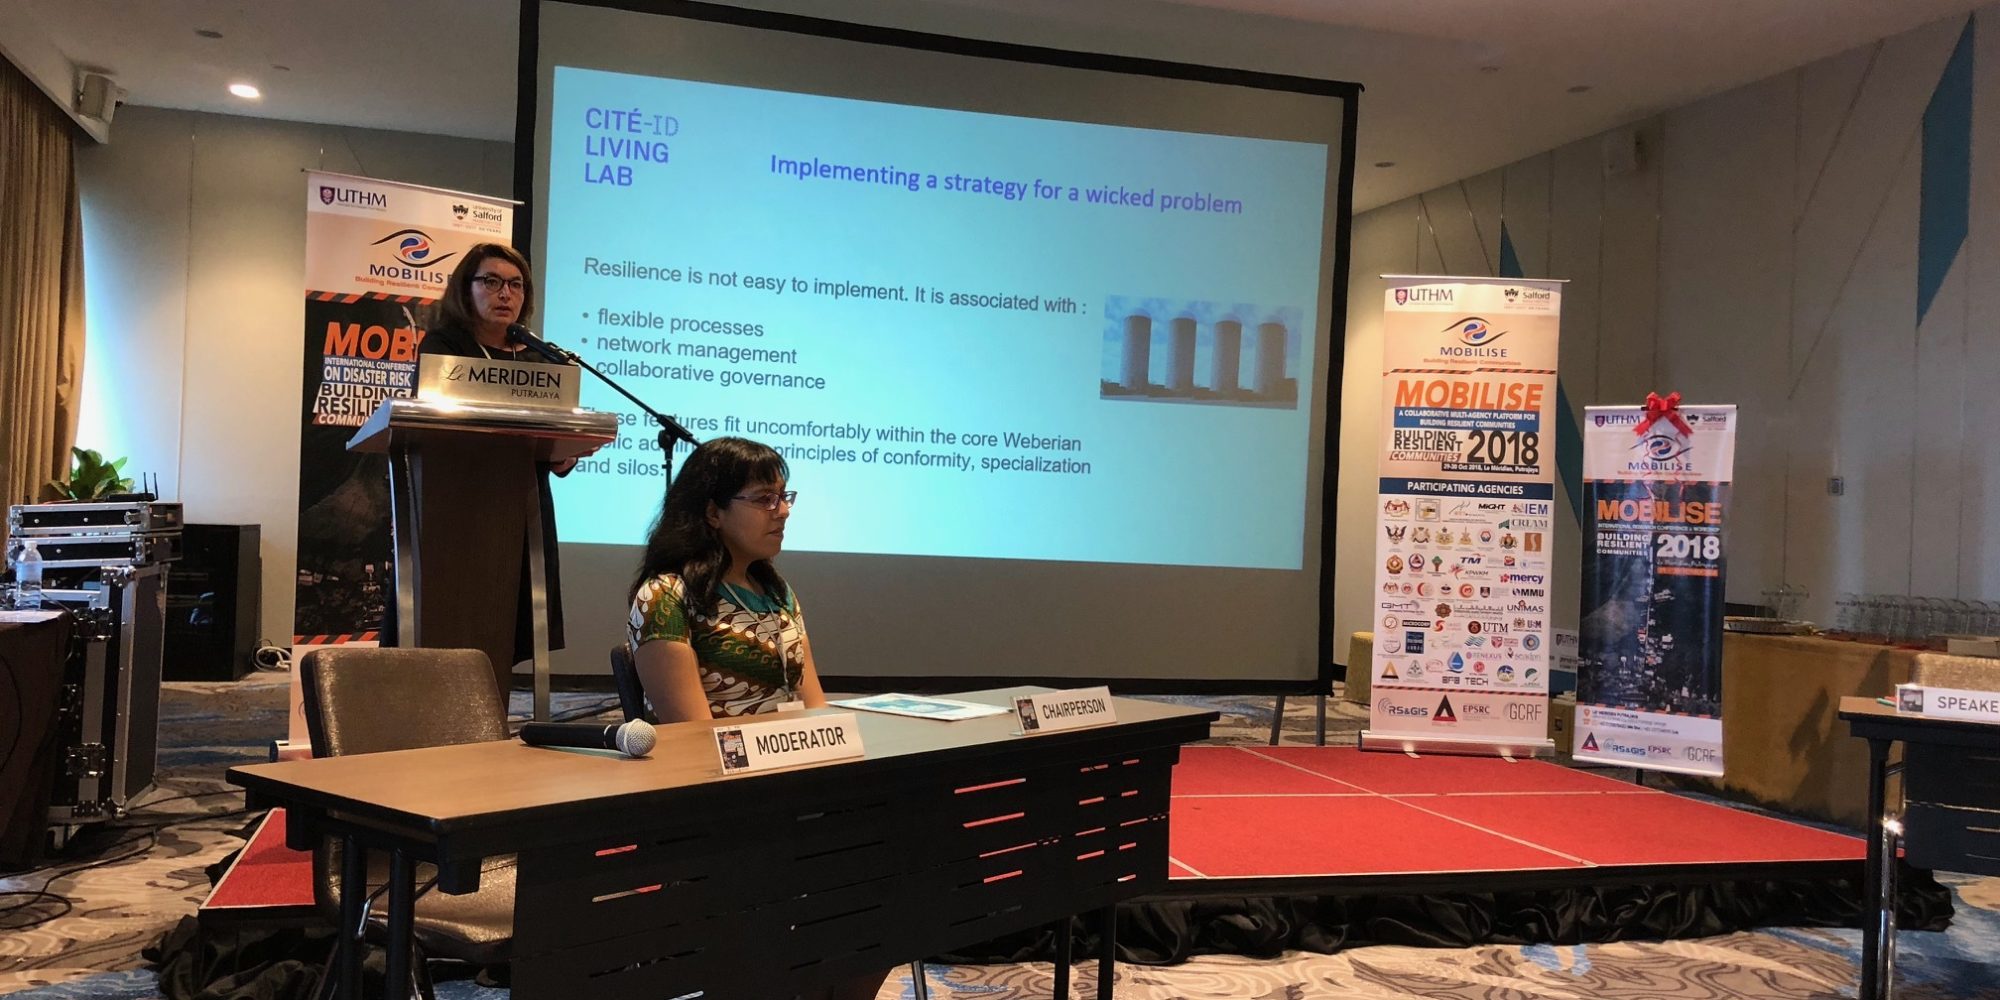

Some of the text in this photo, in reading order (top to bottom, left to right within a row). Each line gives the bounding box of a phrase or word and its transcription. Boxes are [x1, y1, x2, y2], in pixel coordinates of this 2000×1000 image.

[585, 107, 679, 137] CITÉ-ID
[585, 135, 669, 163] LIVING
[584, 162, 633, 186] LAB
[771, 155, 1242, 214] Implementing a strategy for a wicked problem
[337, 188, 387, 207] UTHM
[473, 210, 502, 221] Salford
[370, 264, 453, 284] MOBILIS
[584, 257, 682, 282] Resilience
[688, 266, 703, 284] is
[709, 271, 738, 287] not
[743, 275, 786, 295] easy
[791, 276, 808, 293] to
[813, 278, 908, 301] implement.
[915, 286, 925, 302] It
[931, 287, 944, 304] is
[949, 292, 1039, 311] associated
[1044, 297, 1077, 314] with
[1409, 288, 1453, 302] UTHM
[1523, 291, 1550, 299] Salford
[598, 308, 764, 337] flexible processes
[324, 322, 426, 362] MOBI
[597, 336, 797, 364] network management
[1440, 346, 1507, 358] MOBILISE
[324, 357, 416, 372] INTERNATIONAL CONFERENC
[324, 366, 412, 386] ON DISASTER RISK
[468, 366, 561, 388] MERIDIEN
[596, 359, 826, 390] collaborative governance
[321, 384, 407, 400] BUILDING
[511, 388, 560, 400] PUTRAJAYA
[1395, 380, 1543, 410] MOBILISE
[318, 397, 380, 416] RESILIE
[1404, 410, 1449, 418] COLLABORATIVE
[1450, 411, 1491, 419] MULTI-AGENCY
[1606, 415, 1641, 424] UTHM
[643, 411, 718, 431] feures
[724, 415, 741, 433] fit
[746, 419, 871, 443] uncomfortably
[876, 425, 925, 444] within
[930, 427, 956, 445] the
[961, 432, 998, 448] core
[1003, 431, 1082, 452] Weberian
[1475, 421, 1516, 429] COMMUNITIES
[1394, 430, 1457, 441] BUILDING
[1394, 439, 1463, 451] RESILIENT
[1467, 430, 1539, 465] 2018
[861, 446, 878, 463] of
[883, 450, 975, 472] conformity,
[981, 454, 1091, 474] specialization
[1391, 451, 1459, 461] COMMUNITIES
[575, 458, 610, 473] and
[1628, 462, 1692, 471] MOBILISE
[1407, 481, 1524, 495] PARTICIPATING AGENCIES
[1525, 504, 1548, 515] IEM
[1597, 499, 1722, 524] MOBILISE
[1597, 532, 1649, 541] BUILDING
[1597, 540, 1648, 549] RESILIENT
[1597, 548, 1648, 556] COMMUNITIES
[1657, 534, 1720, 560] 2018
[1460, 556, 1481, 564] TM
[1510, 574, 1544, 584] mercy
[1521, 588, 1544, 597] MMU
[1507, 604, 1544, 612] UNIMAS
[1483, 622, 1508, 633] UTM
[1465, 677, 1488, 685] TECH
[1042, 698, 1106, 719] CHAIRPERSON
[1388, 705, 1428, 716] RS&GIS
[1463, 705, 1490, 714] EPSRC
[1509, 702, 1542, 720] GCRF
[1938, 696, 2000, 713] SPEAKE
[755, 726, 847, 756] MODERATOR
[1612, 744, 1646, 755] RS&GIS
[1687, 746, 1716, 761] GCRF
